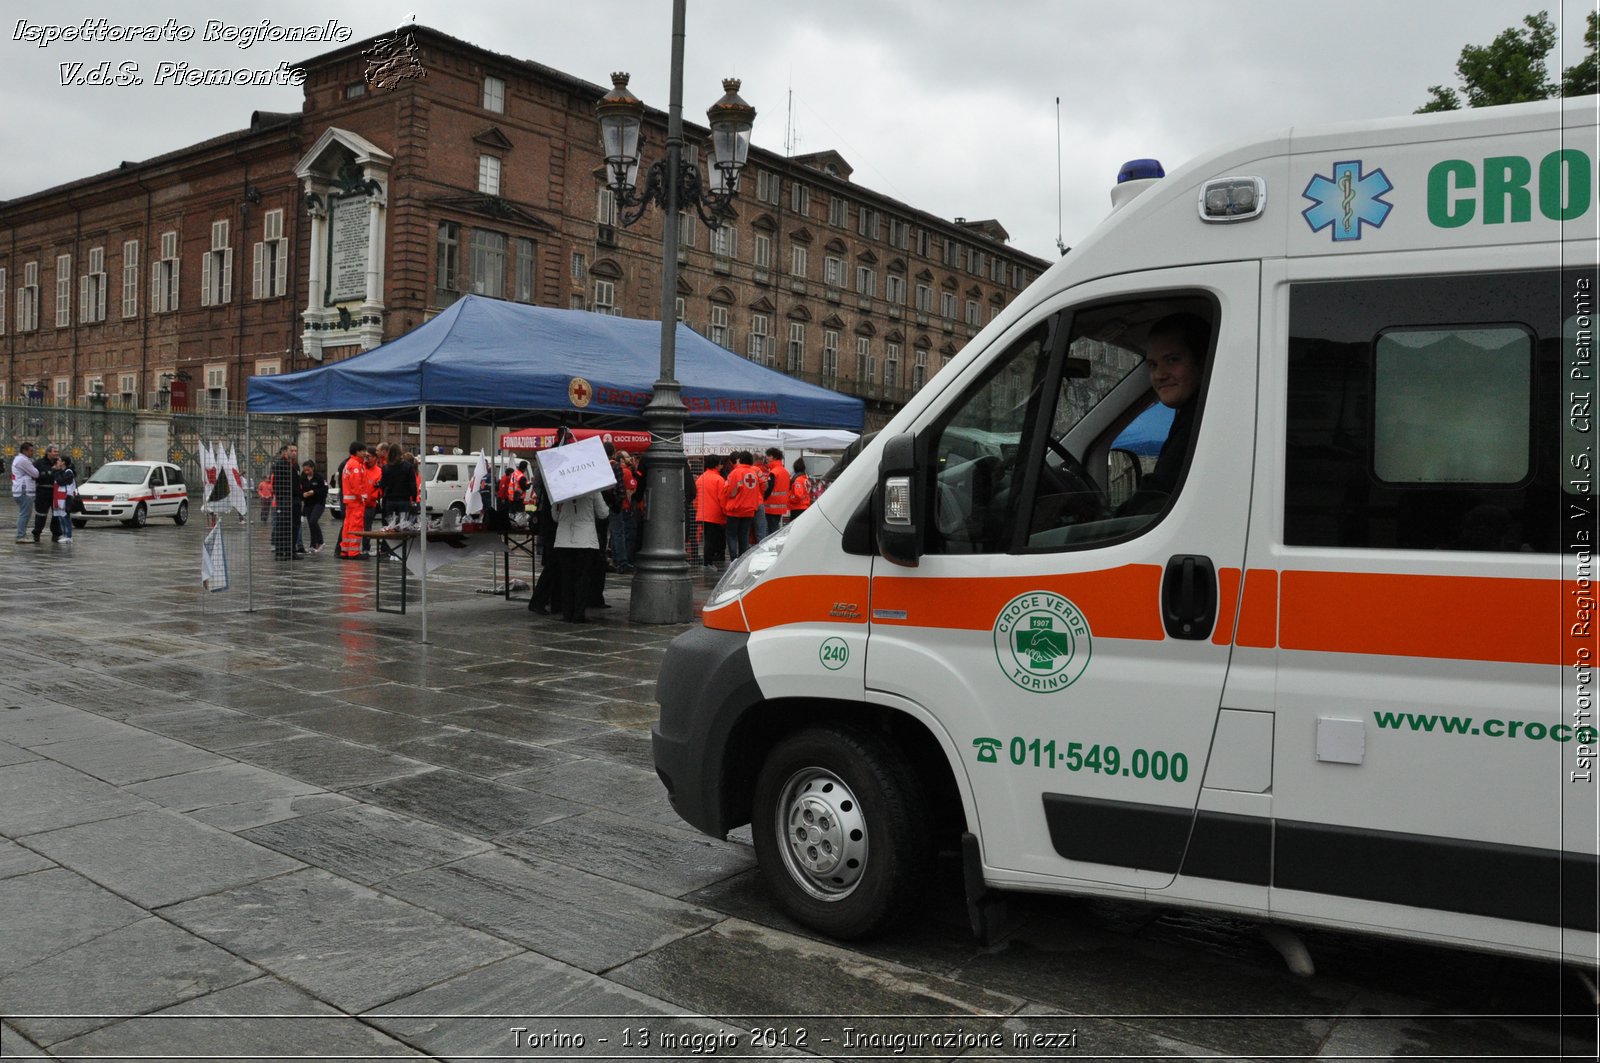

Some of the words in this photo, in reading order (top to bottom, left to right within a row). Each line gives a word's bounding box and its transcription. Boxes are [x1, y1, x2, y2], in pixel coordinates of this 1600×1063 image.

[1427, 149, 1592, 229] CRO
[715, 398, 779, 416] ITALIANA
[503, 436, 537, 448] FONDAZIONE
[558, 461, 596, 476] MAZZONI
[999, 597, 1040, 633] CROCE
[1046, 597, 1085, 637] VERDE
[823, 646, 847, 662] 240
[1013, 668, 1069, 689] TORINO
